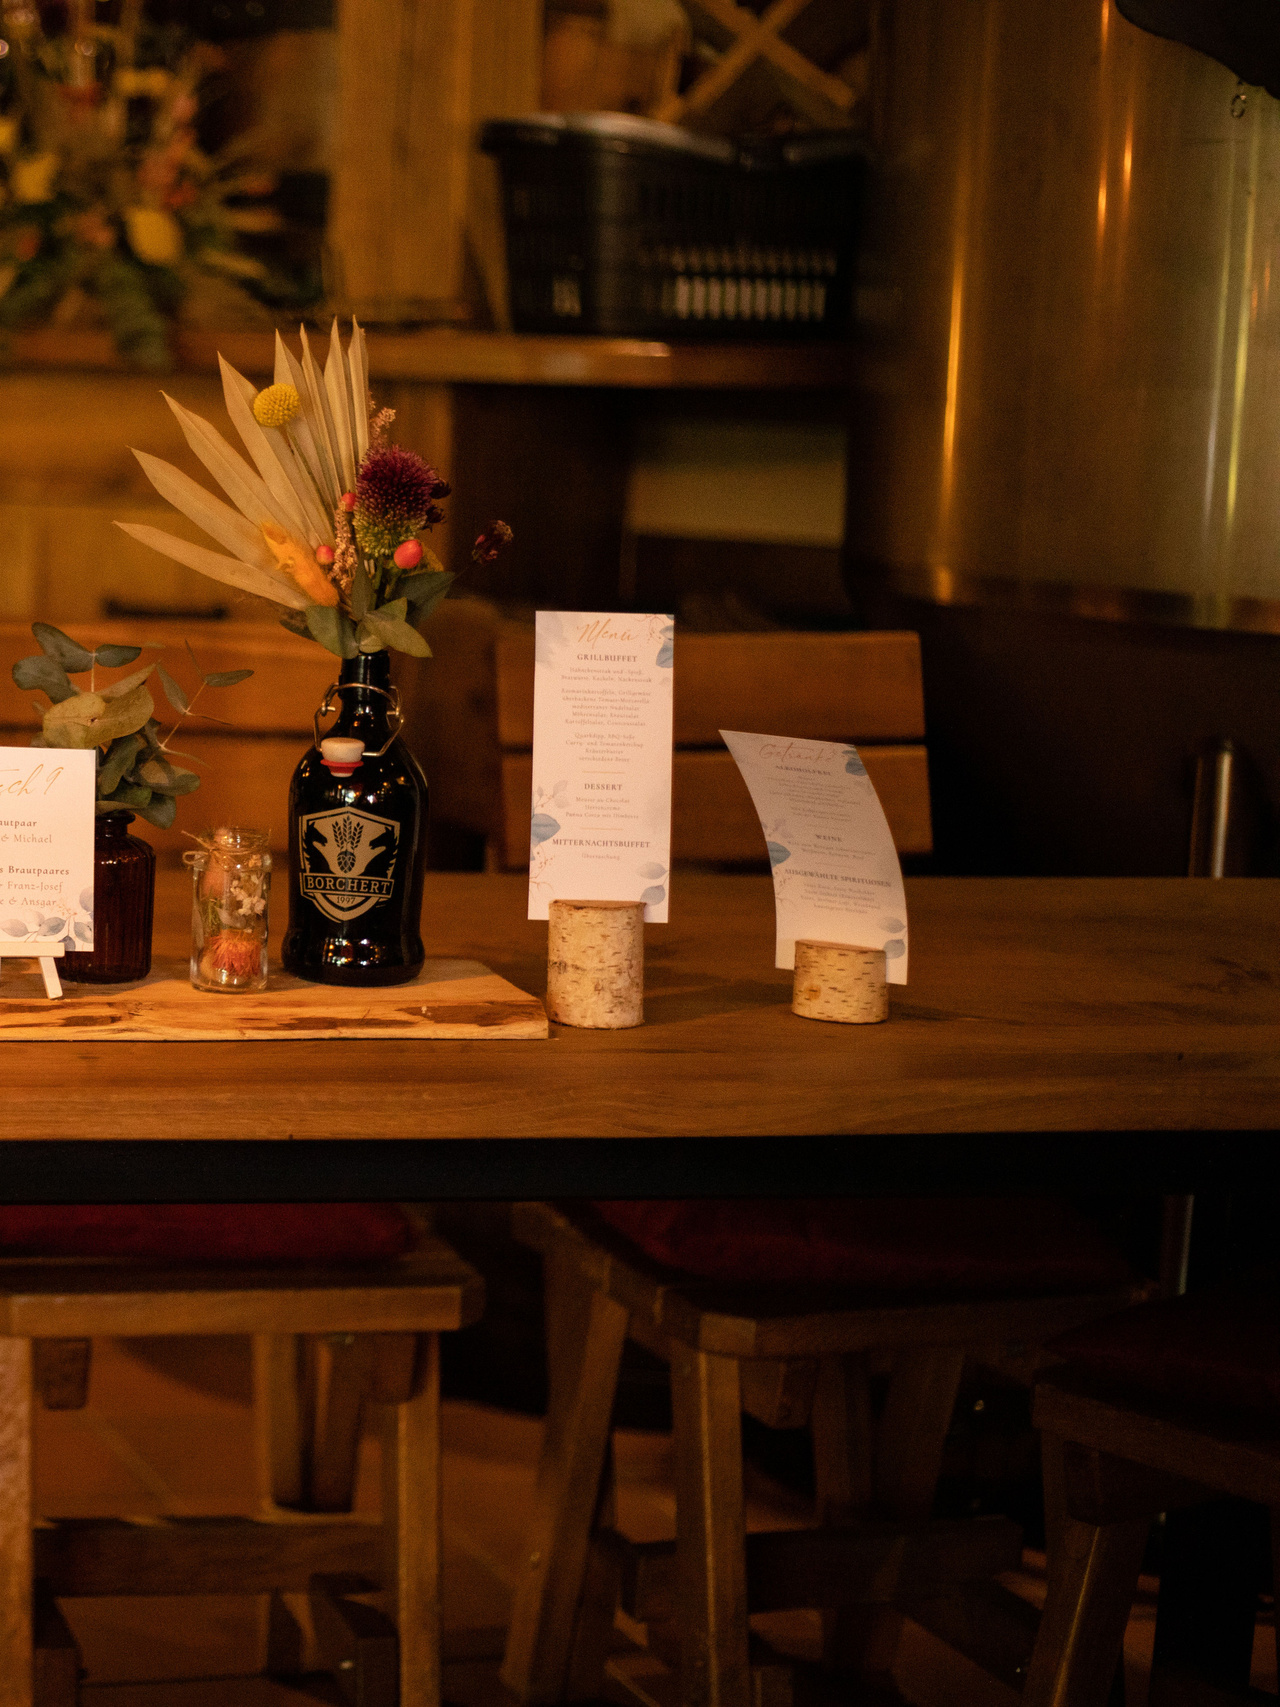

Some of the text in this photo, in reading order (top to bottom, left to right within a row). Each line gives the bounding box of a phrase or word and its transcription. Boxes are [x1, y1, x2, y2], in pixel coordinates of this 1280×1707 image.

[576, 654, 638, 663] GRILLBUFFET
[584, 783, 623, 791] DESSERT
[0, 834, 9, 843] &
[13, 833, 53, 844] Michael
[552, 838, 651, 849] MITTERNACHTSBUFFET
[815, 833, 843, 843] WEINE
[8, 865, 70, 877] Brautpaares
[784, 868, 891, 888] AUSGEWÄHLTE SPIRITUOSEN
[7, 881, 64, 894] Franz-Josef
[306, 876, 390, 894] BORCHERT
[8, 897, 17, 906] &
[20, 897, 57, 909] Ansgar
[336, 896, 356, 904] 1997
